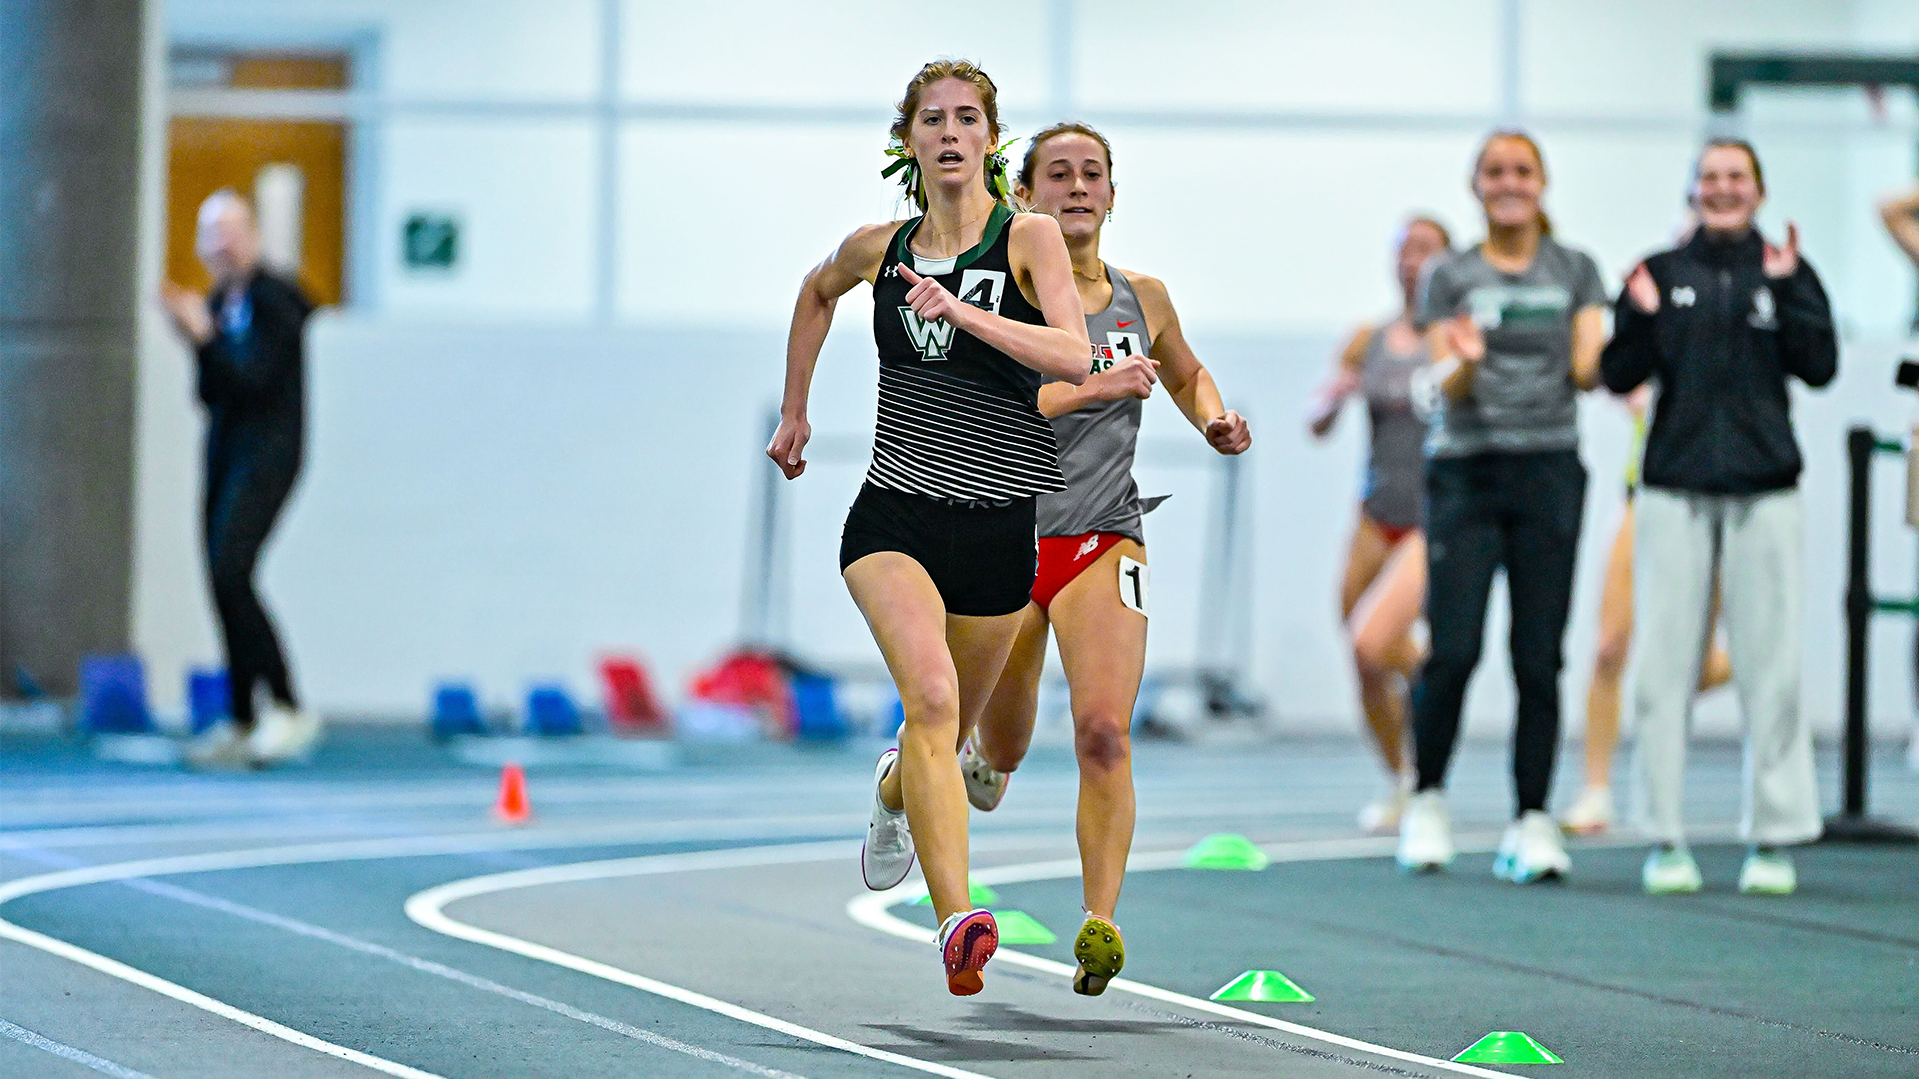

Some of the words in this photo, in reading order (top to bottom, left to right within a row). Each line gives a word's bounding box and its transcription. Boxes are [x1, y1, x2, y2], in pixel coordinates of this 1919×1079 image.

[960, 278, 995, 311] 4
[1116, 337, 1132, 357] 1
[1125, 565, 1143, 610] 1
